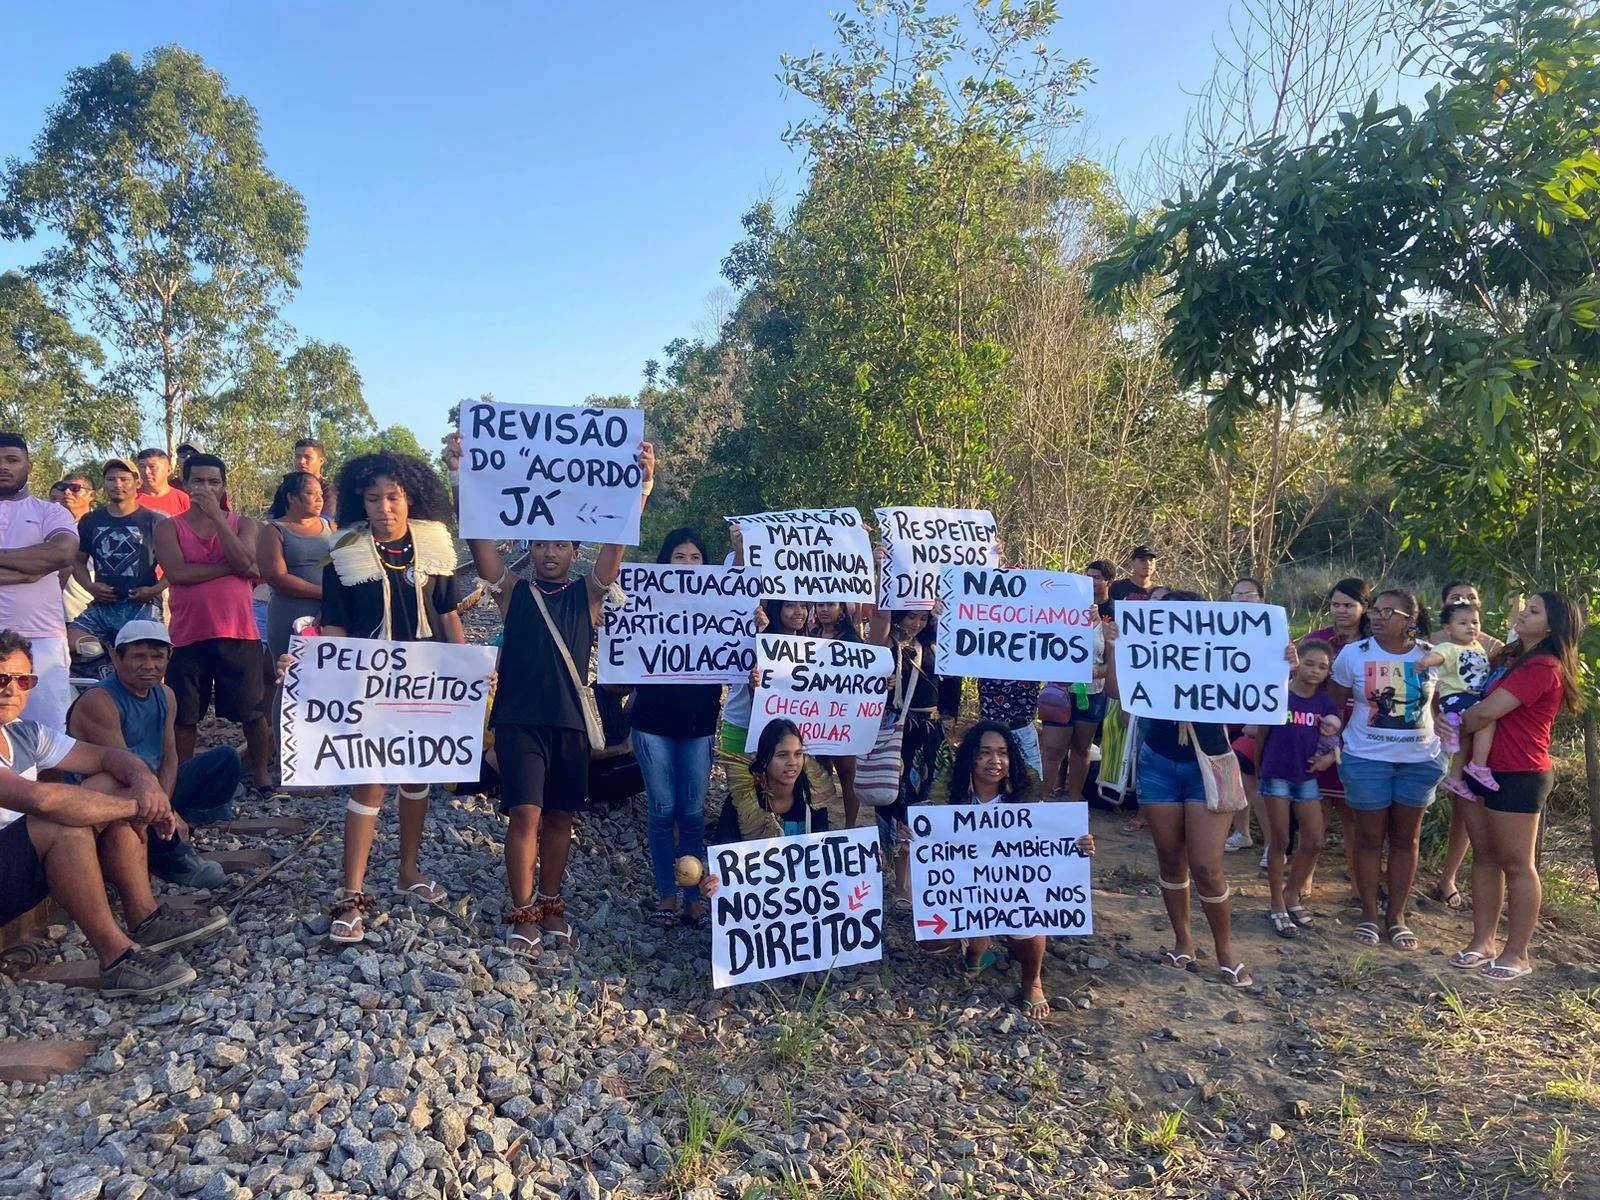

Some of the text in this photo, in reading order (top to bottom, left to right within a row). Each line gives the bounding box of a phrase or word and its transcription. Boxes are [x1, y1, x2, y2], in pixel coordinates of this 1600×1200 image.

[470, 404, 628, 447] REVISÃO
[470, 448, 506, 471] DO
[500, 487, 561, 526] JÁ
[765, 525, 833, 547] MATA
[893, 511, 997, 542] RESPEITEM
[749, 545, 868, 575] E CONTINUA
[912, 544, 987, 566] NOSSOS
[795, 575, 872, 595] MATANDO
[963, 568, 1027, 598] NÃO
[958, 603, 1091, 627] NEGOCIAMOS
[1122, 608, 1271, 636] NENHUM
[317, 642, 407, 671] PELOS
[609, 636, 632, 666] É
[761, 638, 876, 669] VALE, BHP
[955, 628, 1089, 663] DIREITOS
[1128, 641, 1251, 673] DIREITO
[365, 672, 484, 701] DIREITOS
[761, 665, 888, 695] E SAMARCO
[765, 694, 884, 717] CHEGA DE NOS
[1130, 681, 1279, 712] A MENOS
[305, 700, 364, 724] DOS
[314, 730, 473, 770] ATINGIDOS
[913, 807, 1032, 837] O MAIOR
[717, 835, 883, 886] RESPEITEM
[916, 836, 1089, 864] CRIME AMBIENTAL
[928, 865, 1051, 886] DO MUNDO
[717, 880, 840, 926] NOSSOS
[922, 885, 1086, 907] CONTINUA NOS
[950, 907, 1086, 932] IMPACTANDO
[726, 909, 883, 976] DIREITOS
